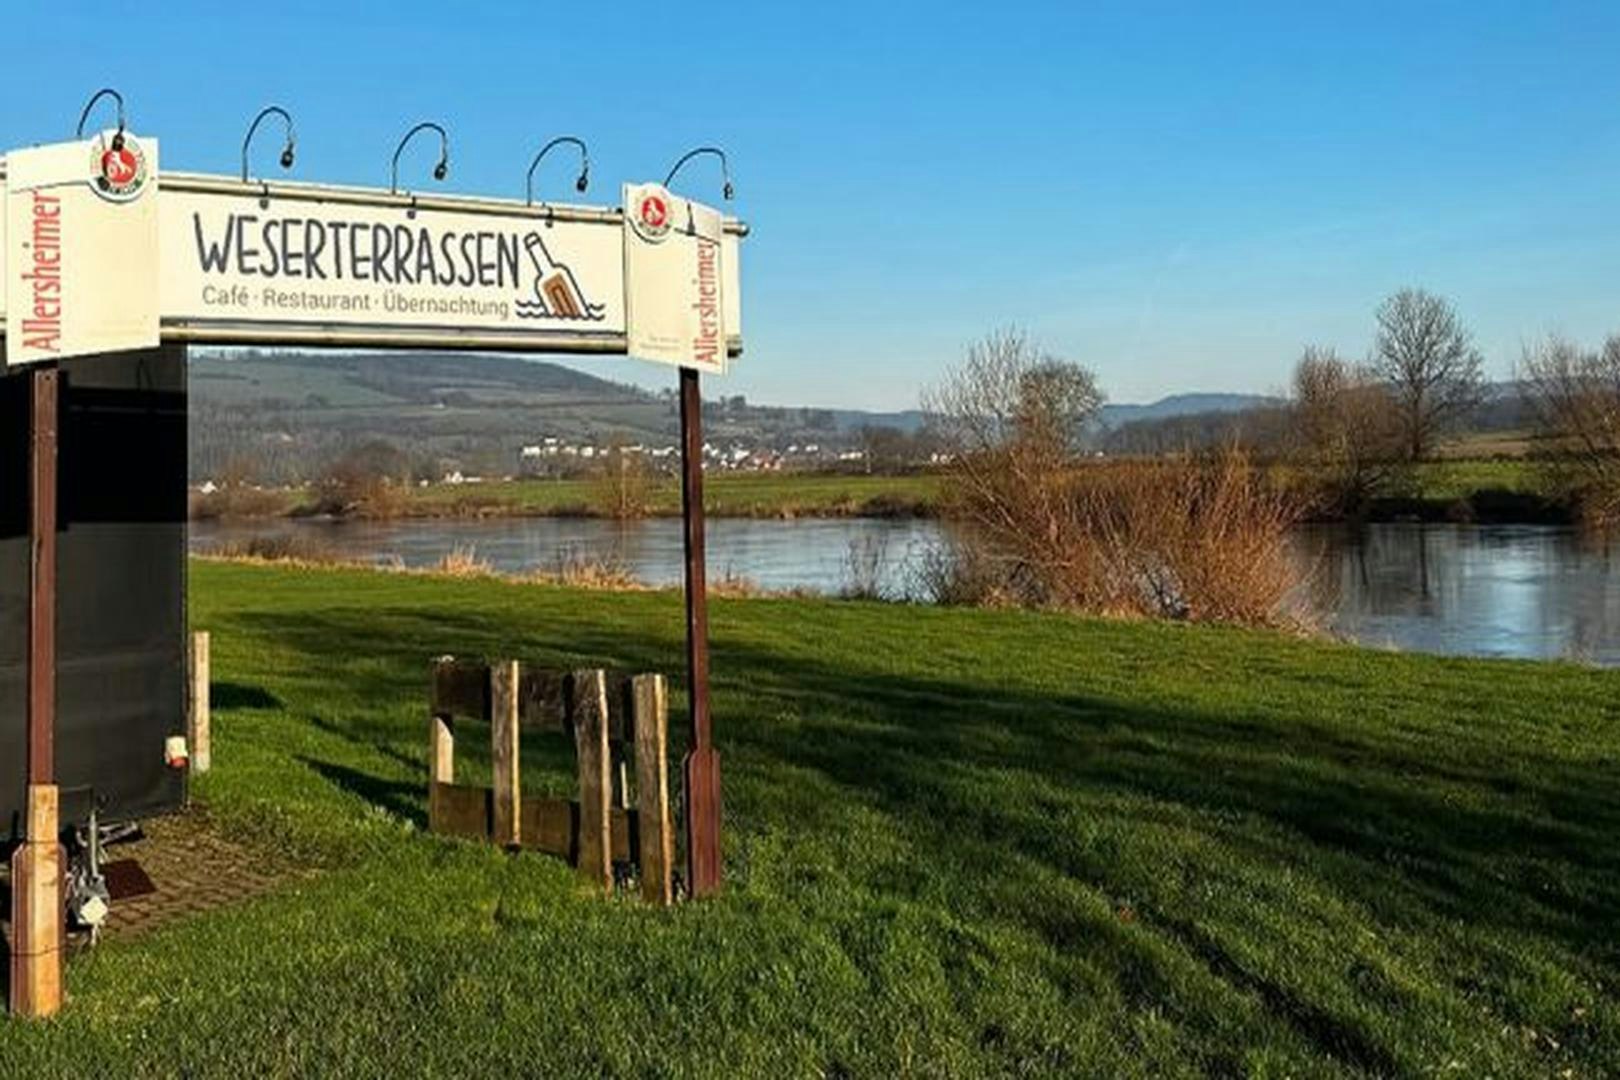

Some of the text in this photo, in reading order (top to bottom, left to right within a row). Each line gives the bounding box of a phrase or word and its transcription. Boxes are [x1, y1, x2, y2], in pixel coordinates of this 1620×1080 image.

[21, 188, 61, 353] Allersheimer
[193, 211, 521, 289] WESERTERRASSEN
[691, 236, 720, 366] Allersheimer
[202, 285, 509, 320] Café Restaurant Übernachtung
